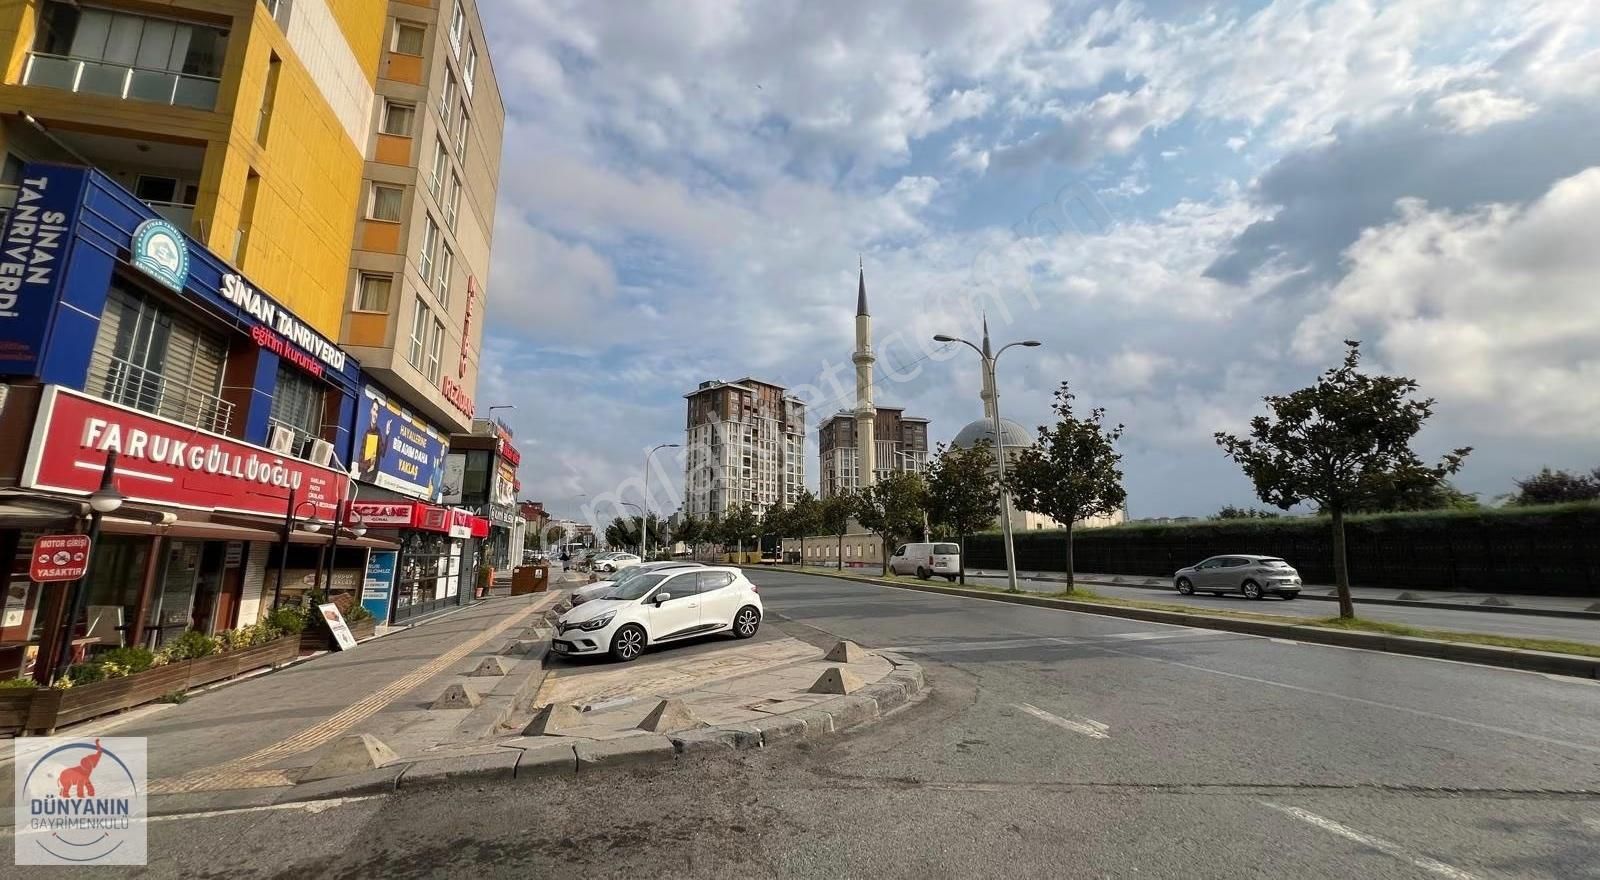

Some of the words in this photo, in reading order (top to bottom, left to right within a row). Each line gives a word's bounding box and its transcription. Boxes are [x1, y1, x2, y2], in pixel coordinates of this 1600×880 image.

[0, 176, 48, 318] TANRIVERDİ
[25, 210, 68, 285] SİNAN
[219, 273, 275, 329] SİNAN
[276, 311, 346, 373] TANRIVERDİ
[252, 325, 283, 355] eğitim
[81, 416, 303, 491] FARUKGÜLLÜOĞLU
[350, 505, 409, 518] ECZANE
[40, 539, 66, 549] MOTOR
[66, 538, 87, 549] GİRİŞİ
[37, 567, 82, 577] YASAKTIR
